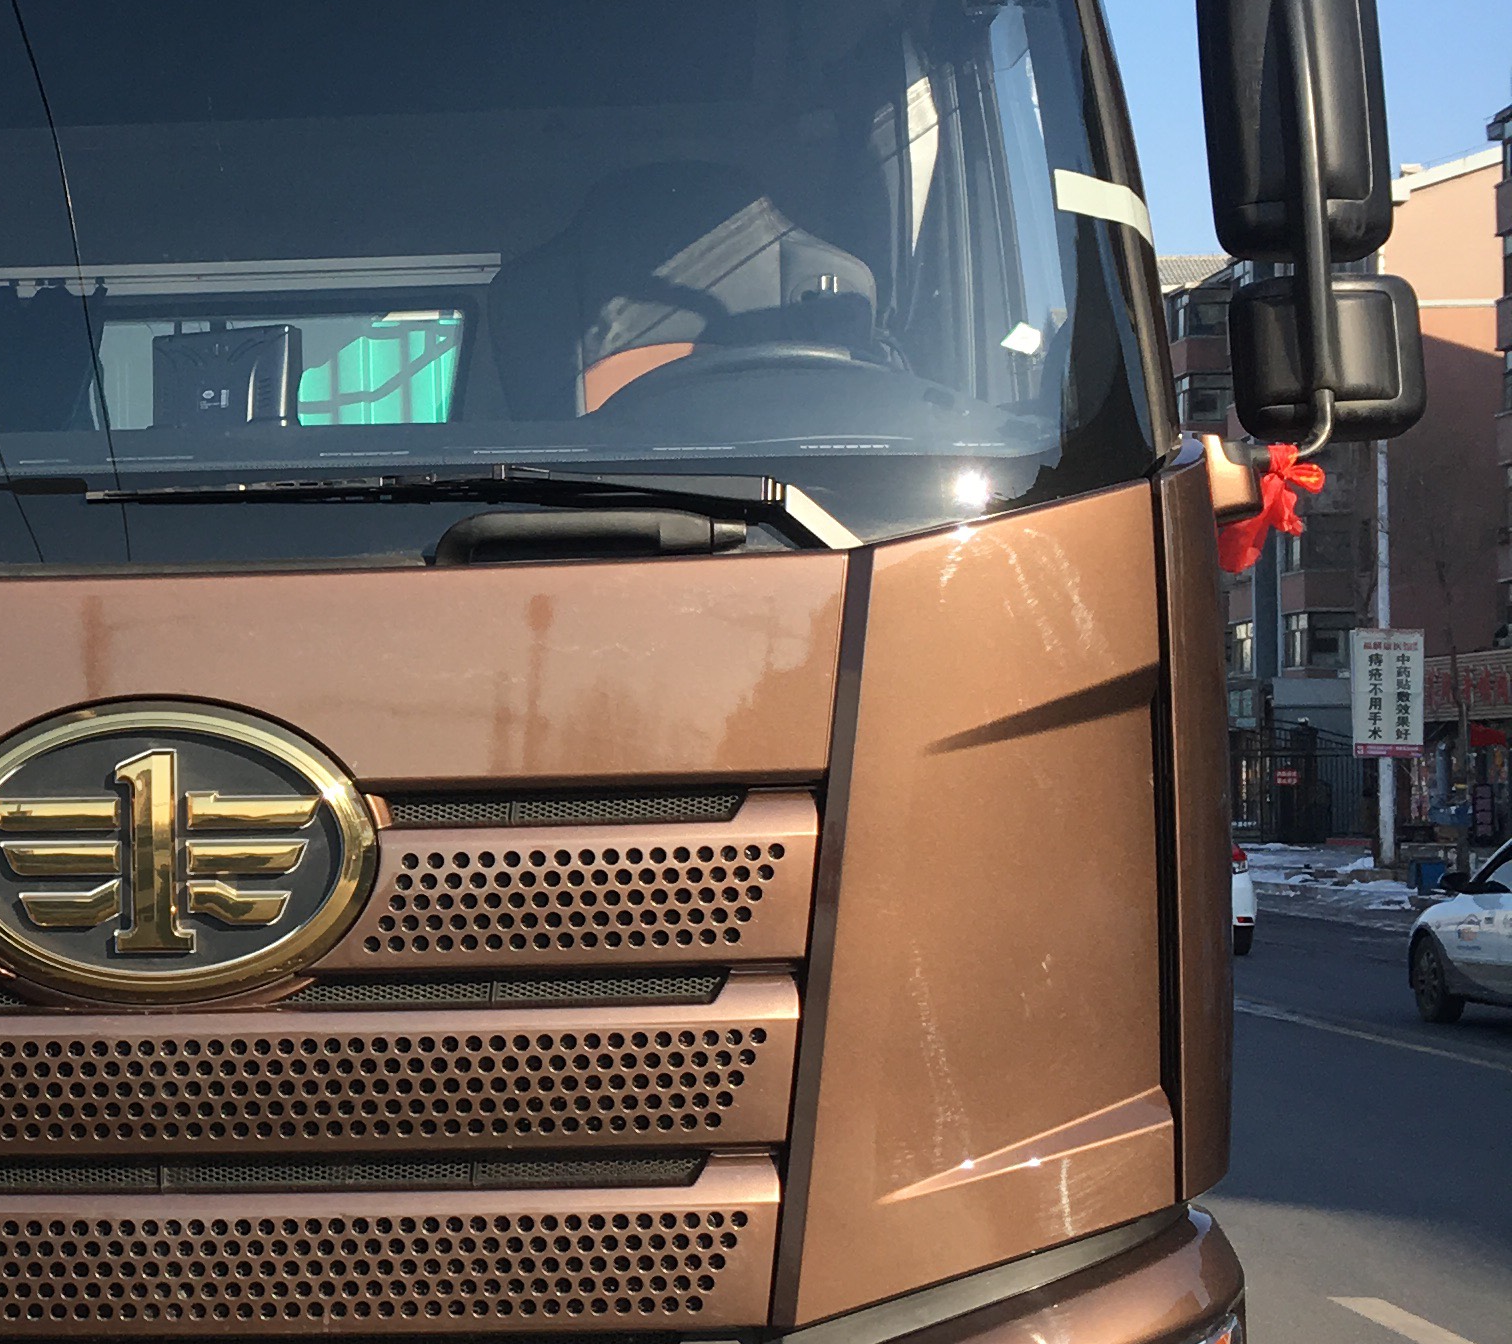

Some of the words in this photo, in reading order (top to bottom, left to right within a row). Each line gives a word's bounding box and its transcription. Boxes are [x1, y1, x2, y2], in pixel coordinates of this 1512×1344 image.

[1368, 653, 1383, 740] 痔疮不用手术
